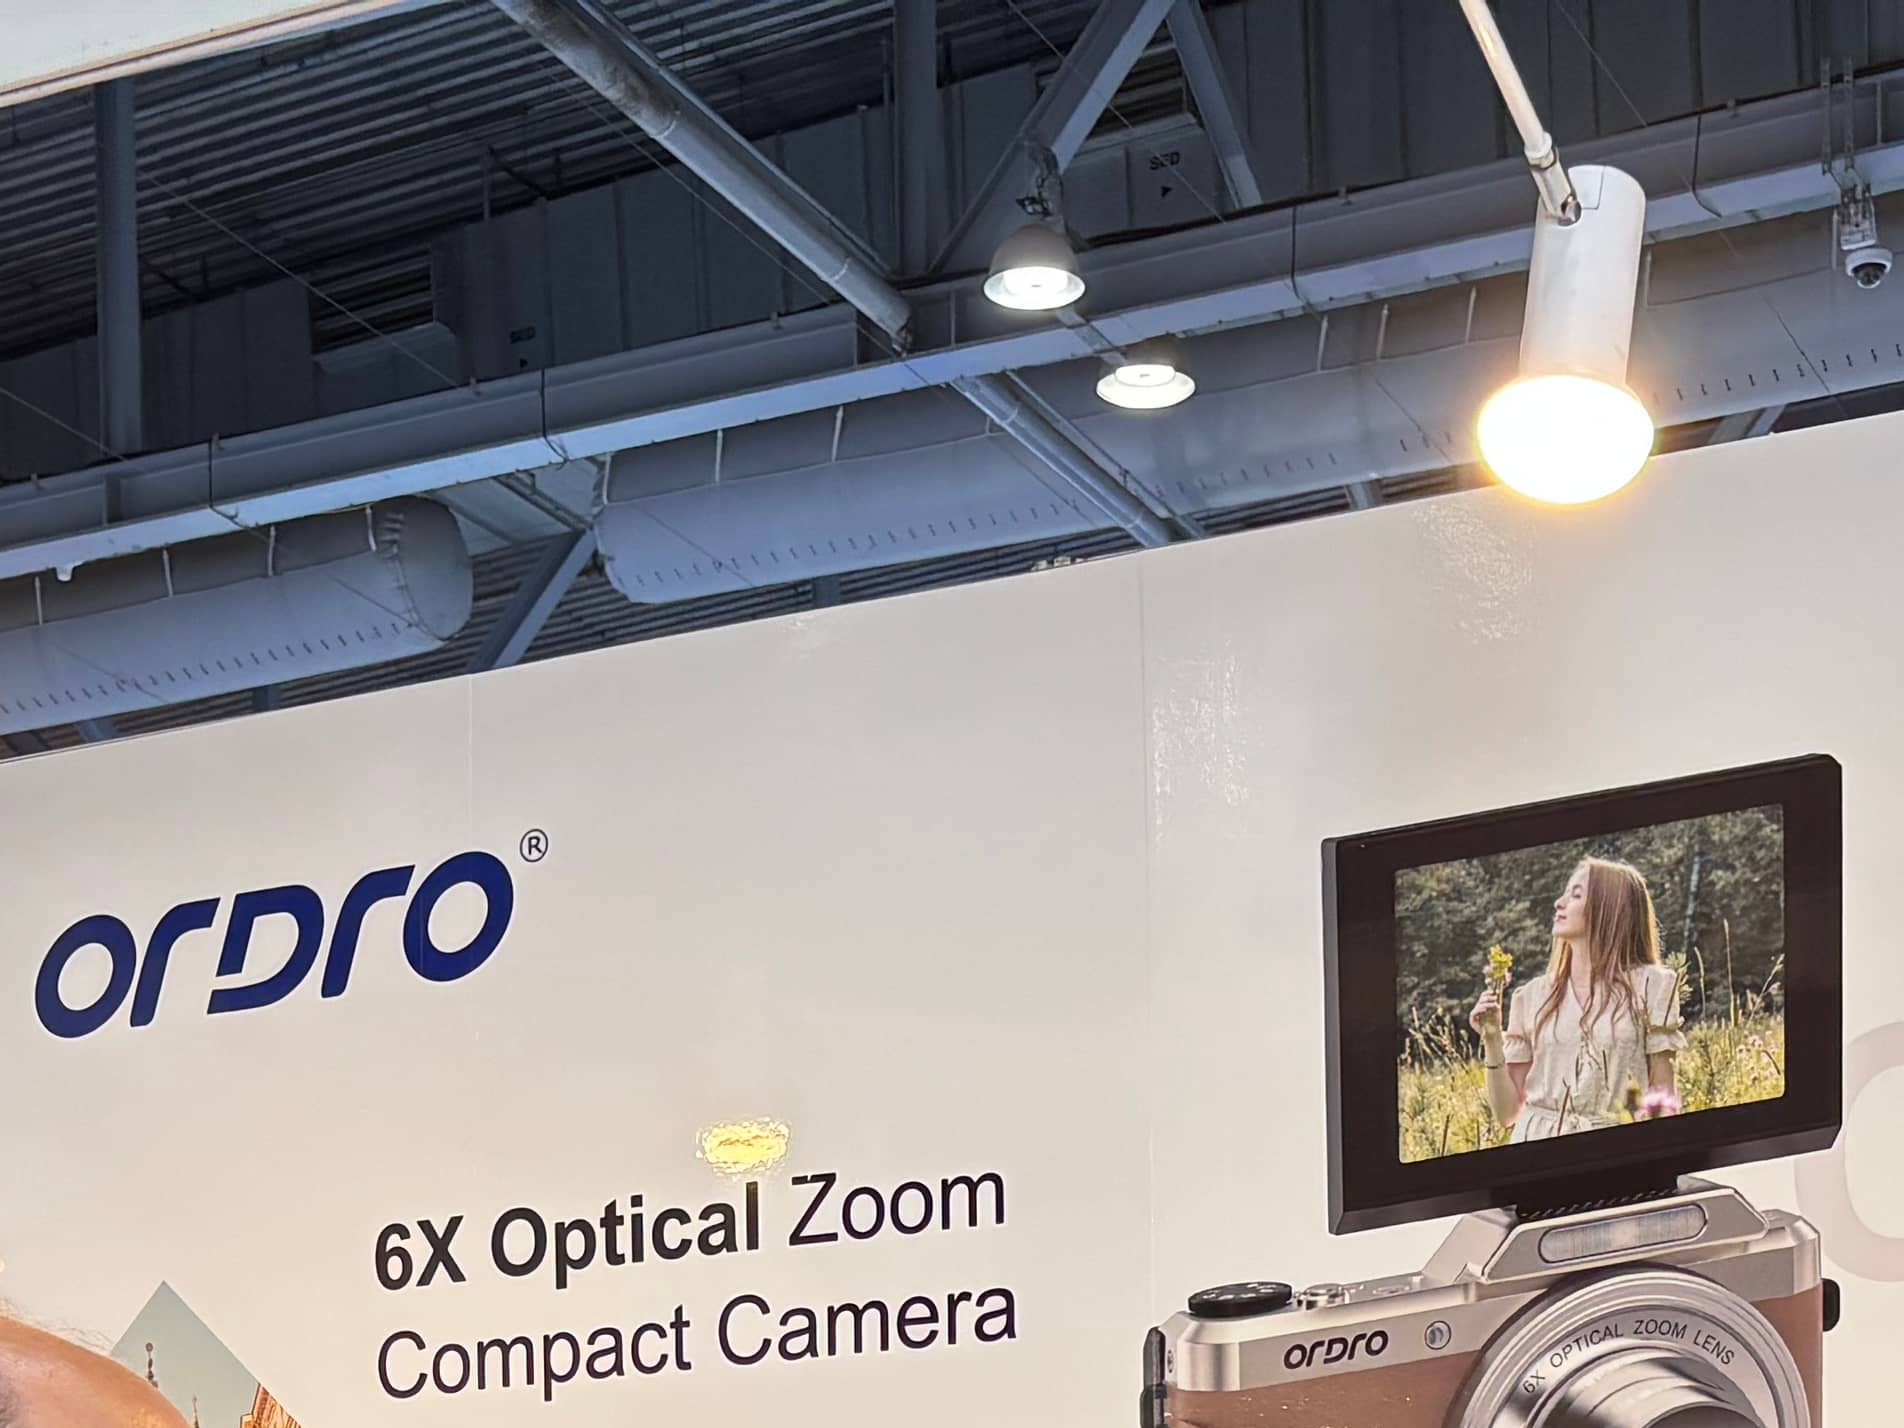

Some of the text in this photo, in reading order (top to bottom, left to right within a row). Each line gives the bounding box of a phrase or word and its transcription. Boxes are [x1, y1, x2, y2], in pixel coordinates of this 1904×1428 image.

[374, 1170, 1007, 1292] 6X Optical Zoom
[377, 1282, 1018, 1401] Compact Camera
[1522, 1319, 1735, 1394] 6X OPTICAL ZOOM LENS
